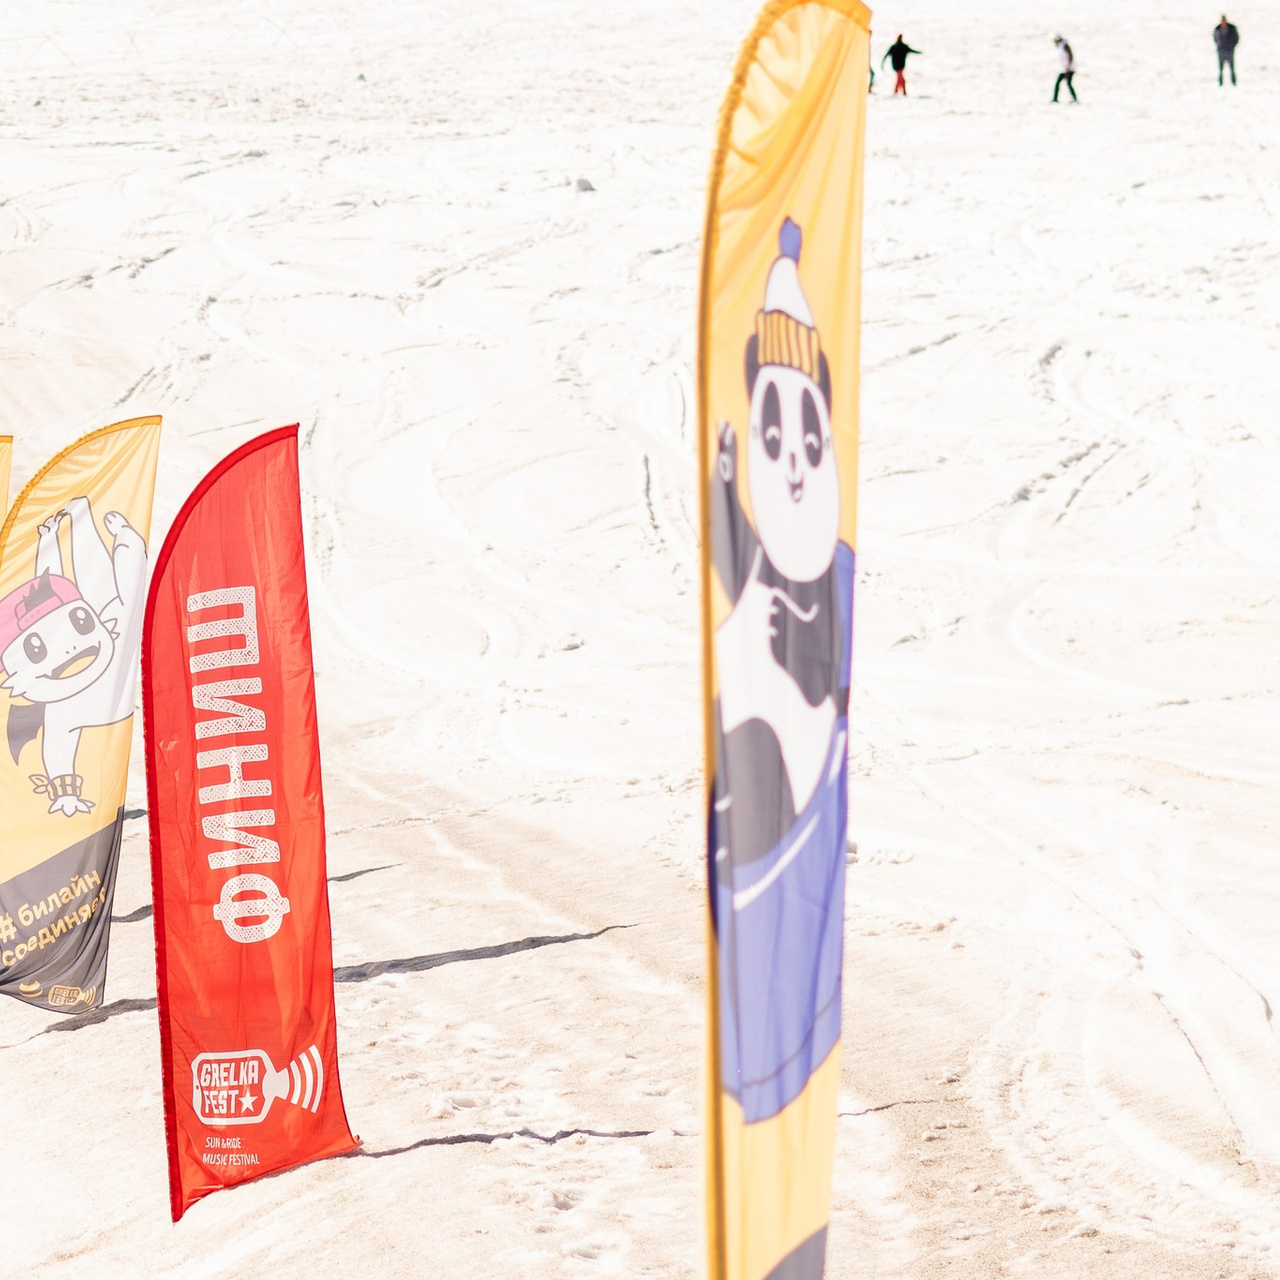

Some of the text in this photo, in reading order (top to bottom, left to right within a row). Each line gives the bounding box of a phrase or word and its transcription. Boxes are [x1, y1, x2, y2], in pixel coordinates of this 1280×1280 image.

[186, 585, 291, 943] ФИНИШ
[17, 869, 101, 927] билайн
[200, 1060, 259, 1087] GRELKA
[203, 1089, 239, 1114] FEST
[205, 1137, 220, 1148] SUN
[202, 1153, 260, 1166] MUSIC FESTIVAL
